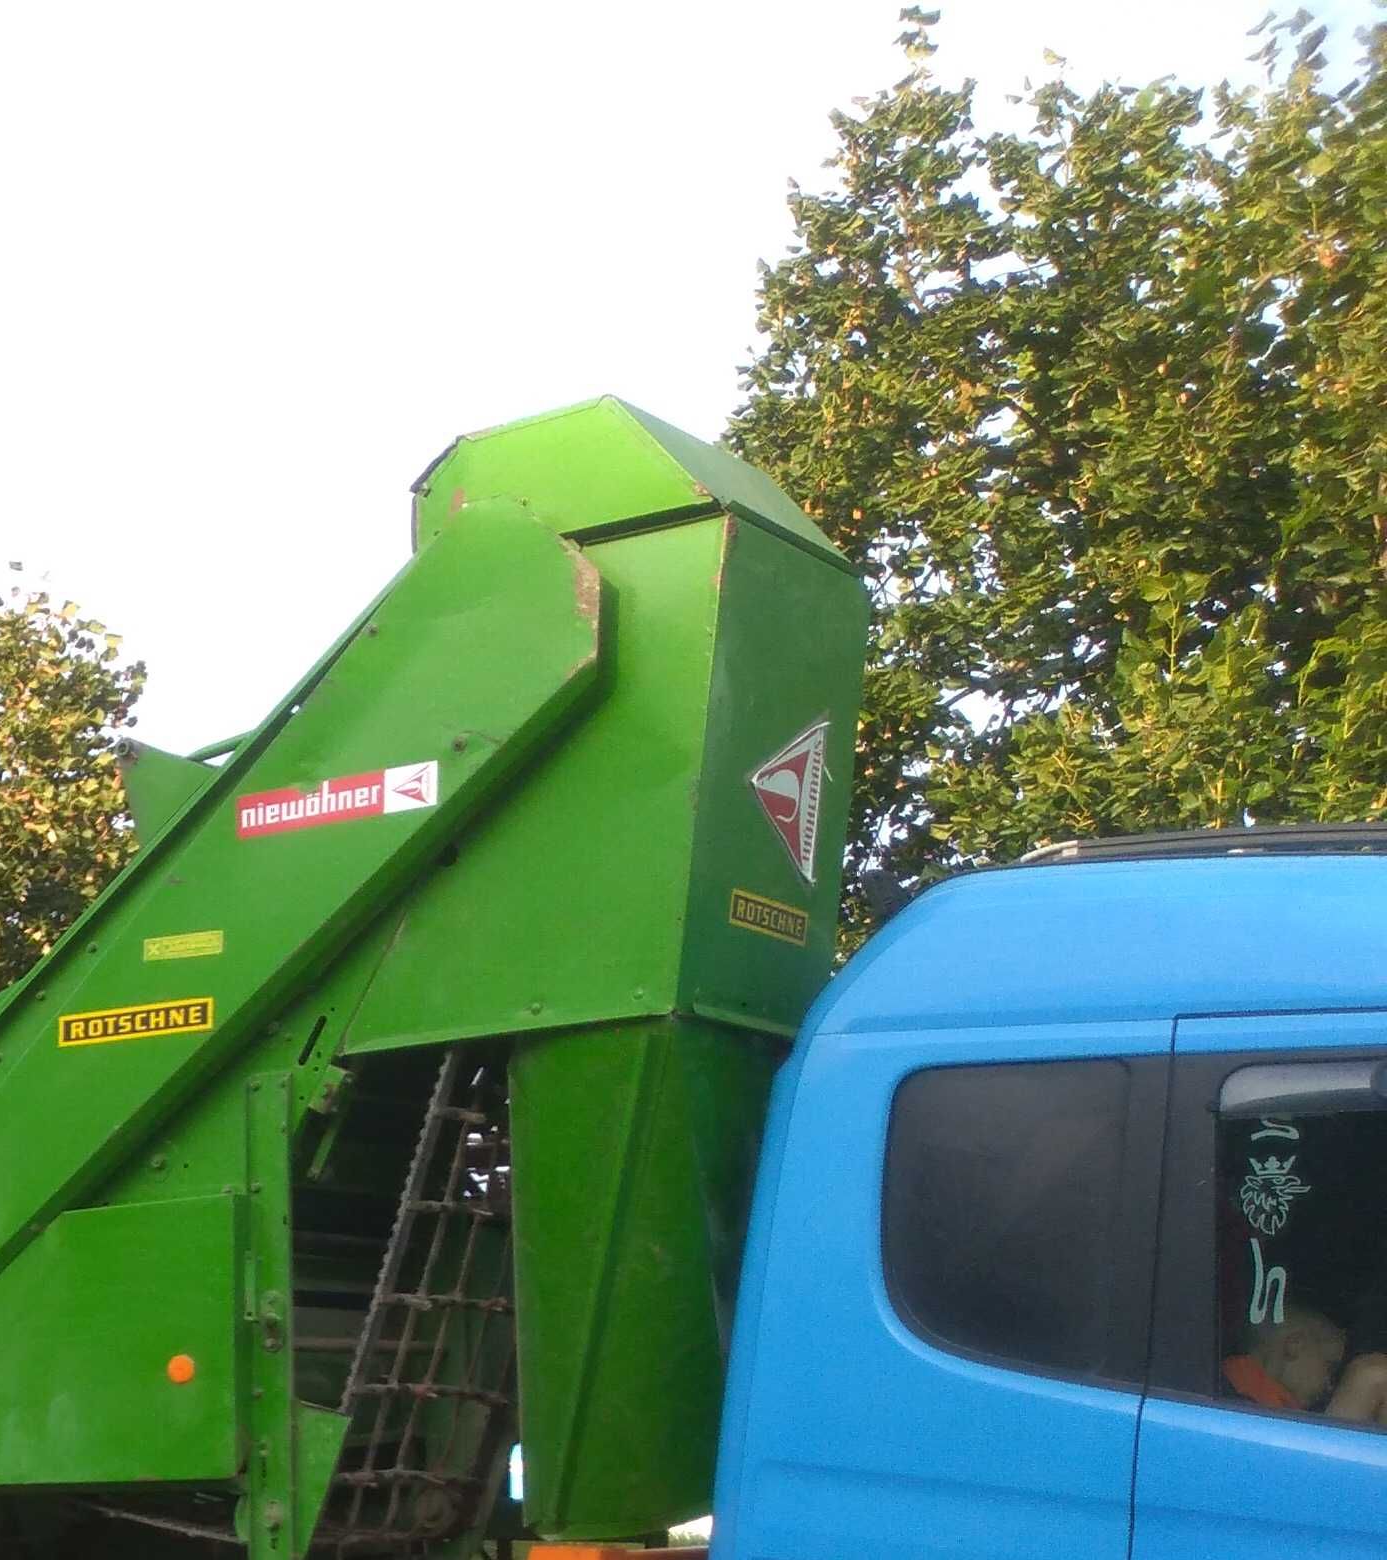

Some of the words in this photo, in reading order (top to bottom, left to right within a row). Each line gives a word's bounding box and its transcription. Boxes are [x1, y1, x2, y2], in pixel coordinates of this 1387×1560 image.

[241, 780, 381, 828] niewöhner
[736, 898, 803, 939] ROTSCHNE
[70, 1005, 203, 1040] ROTSCHNE
